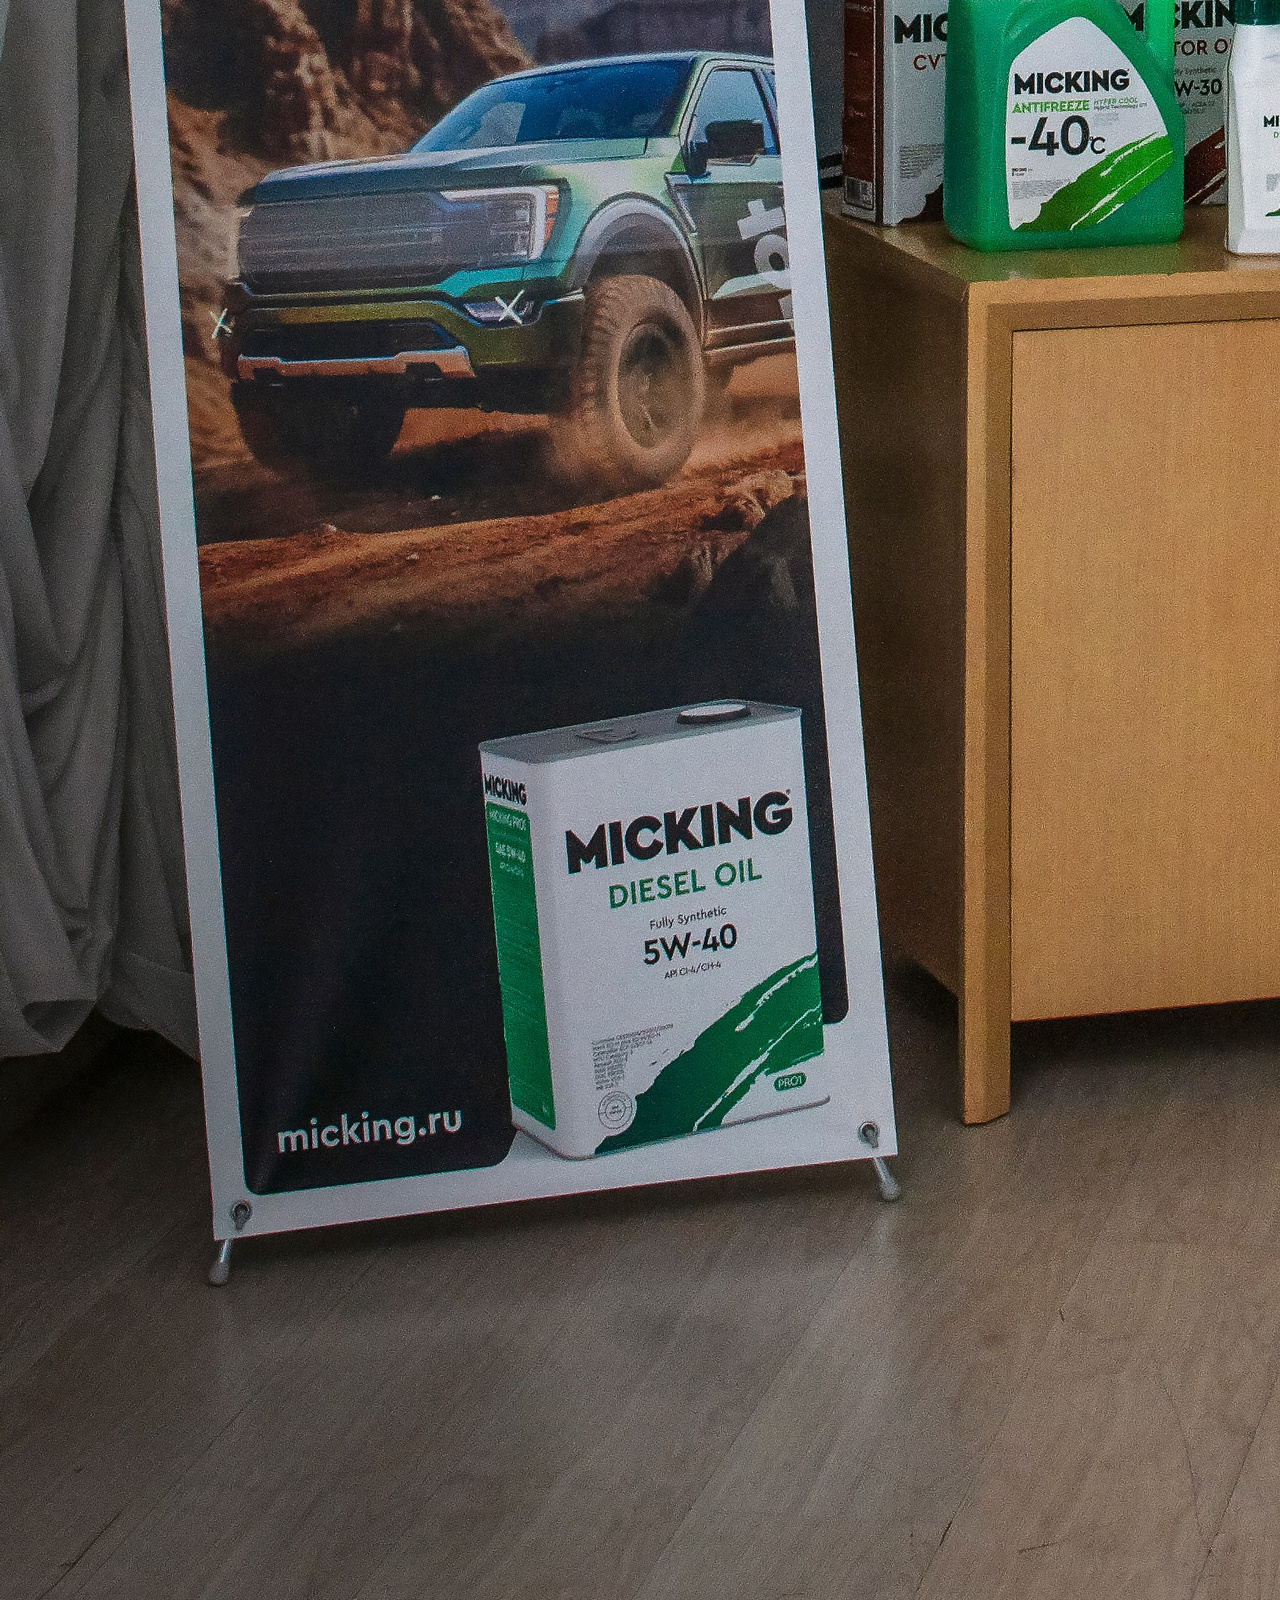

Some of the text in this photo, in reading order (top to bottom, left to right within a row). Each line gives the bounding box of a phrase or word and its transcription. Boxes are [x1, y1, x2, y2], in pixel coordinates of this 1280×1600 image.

[1013, 69, 1130, 96] MICKING
[1012, 100, 1090, 114] ANTIFREEZE
[484, 774, 527, 805] MICKING
[566, 789, 793, 874] MICKING
[609, 858, 763, 909] DIESEL OIL
[650, 906, 727, 930] Fully Synthetic
[644, 923, 737, 965] 5W-40
[664, 969, 678, 979] API
[278, 1109, 463, 1154] micking.ru
